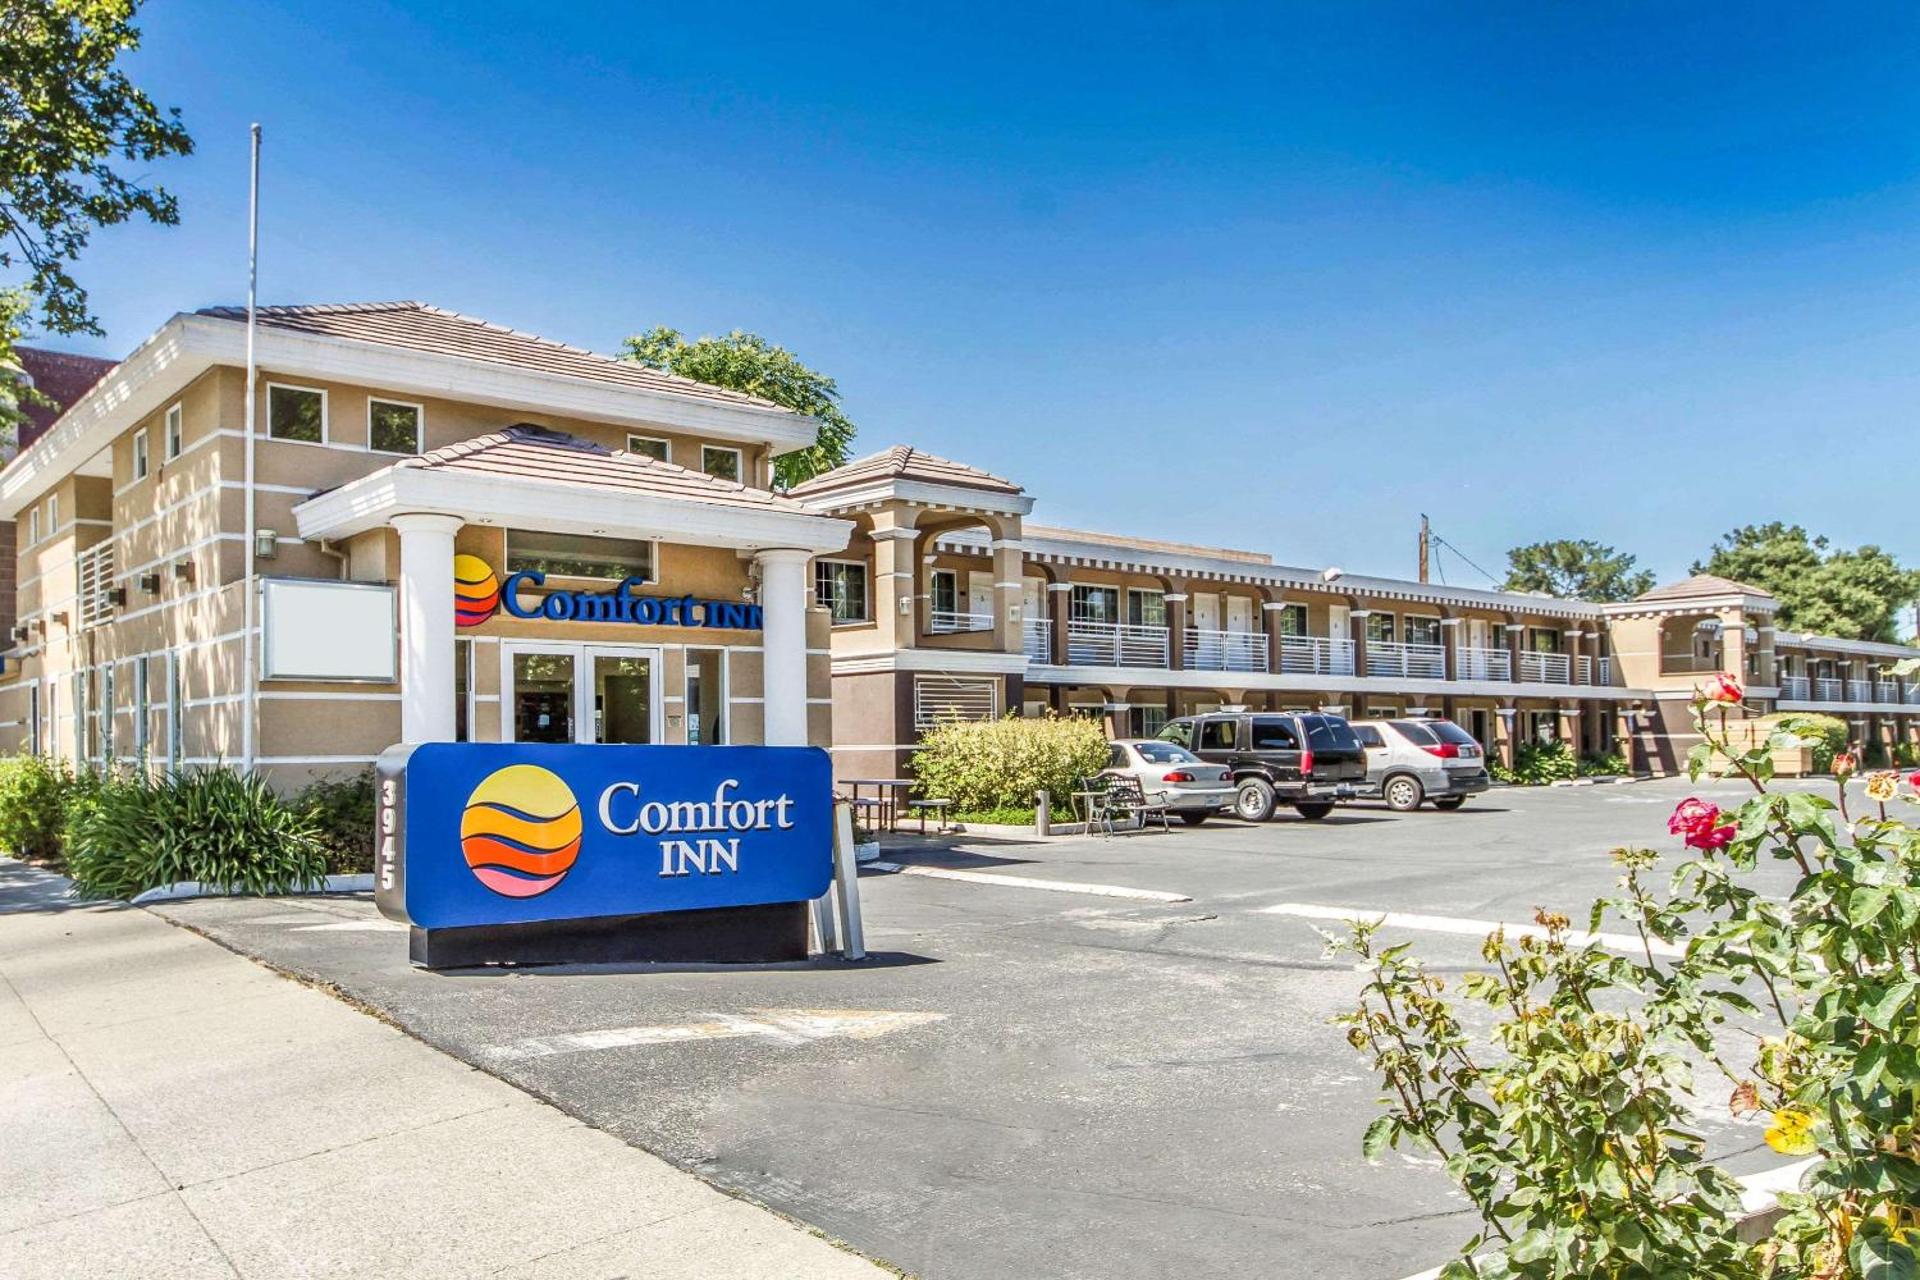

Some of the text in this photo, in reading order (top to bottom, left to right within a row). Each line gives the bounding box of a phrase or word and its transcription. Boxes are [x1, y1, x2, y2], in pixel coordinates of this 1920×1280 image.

[501, 570, 702, 627] Comfort
[381, 779, 396, 890] 3945
[598, 779, 795, 835] Comfort
[658, 838, 741, 877] INN
